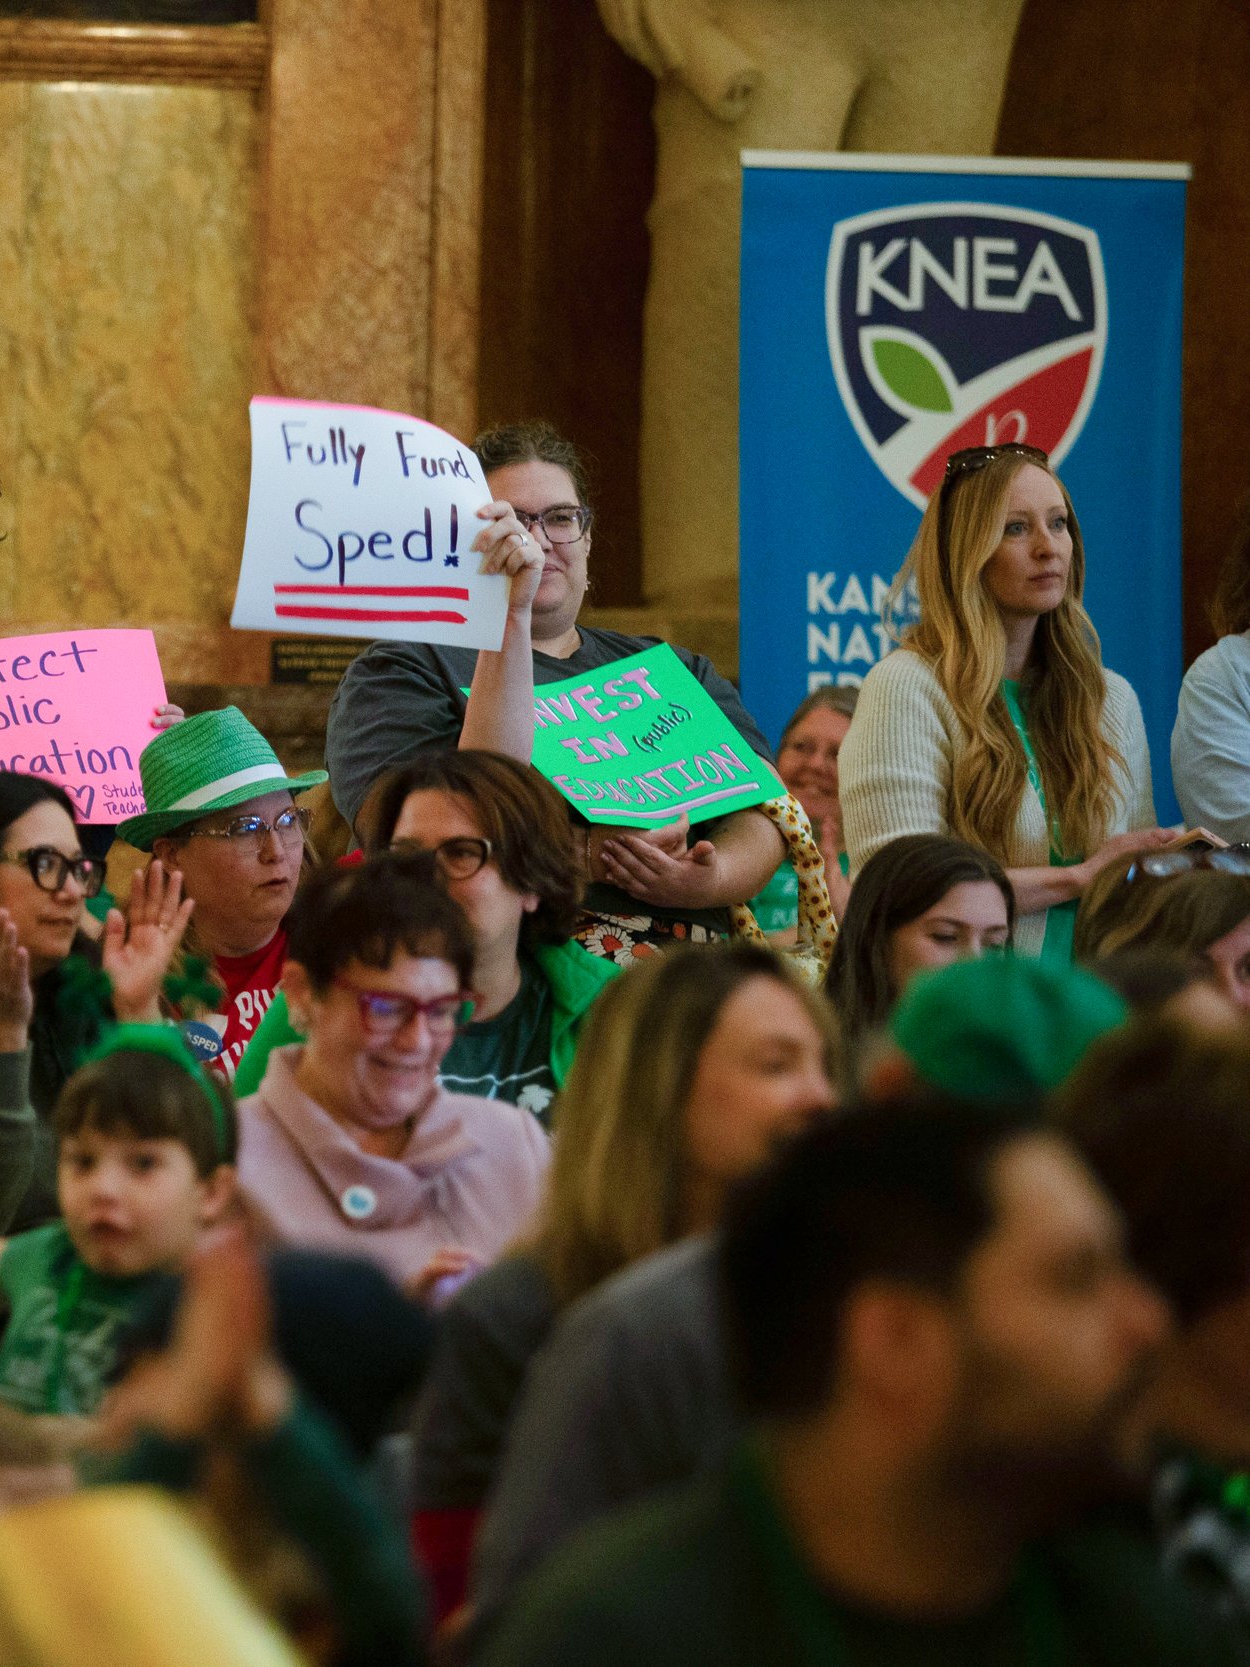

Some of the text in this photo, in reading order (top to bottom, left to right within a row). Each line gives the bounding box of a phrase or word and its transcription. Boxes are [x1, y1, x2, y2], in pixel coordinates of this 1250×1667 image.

[855, 235, 1083, 322] KNEA
[281, 420, 476, 487] Fully Fund
[294, 498, 460, 586] Sped!
[807, 571, 920, 616] KAN
[807, 621, 908, 666] NAT
[533, 666, 663, 730] NVEST
[559, 702, 693, 765] IN (public)
[101, 780, 145, 798] Stude
[551, 743, 752, 806] EDUCATION
[103, 801, 147, 815] Teache
